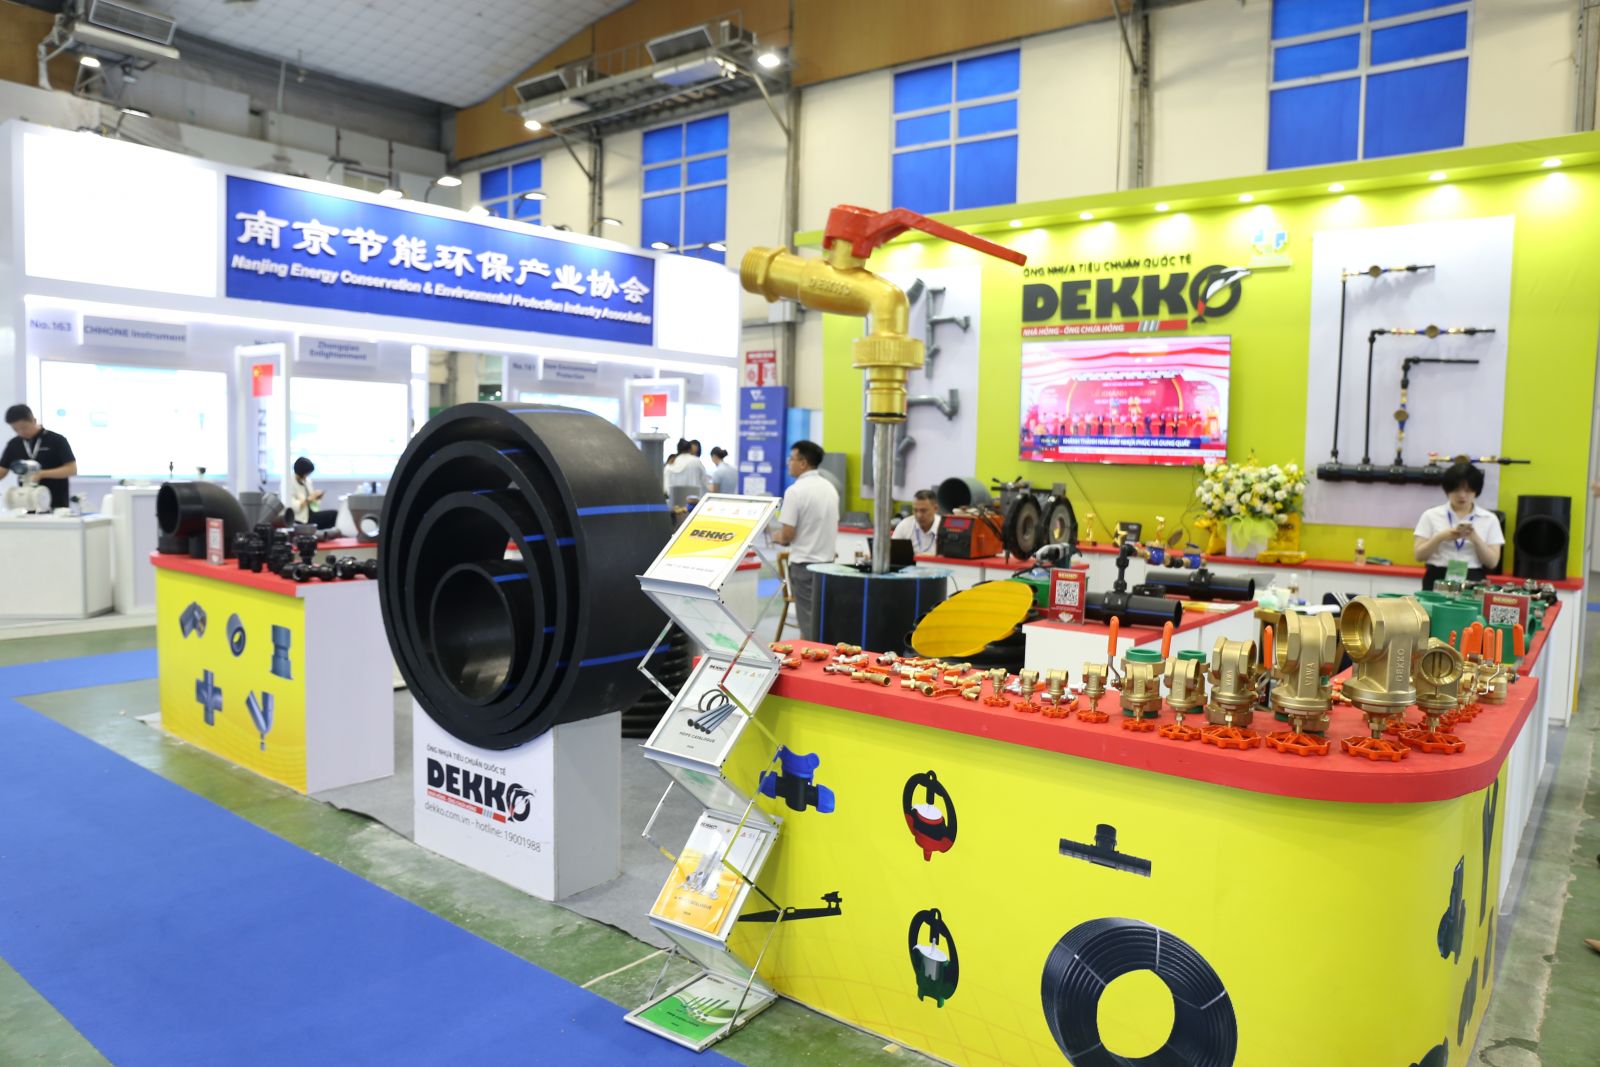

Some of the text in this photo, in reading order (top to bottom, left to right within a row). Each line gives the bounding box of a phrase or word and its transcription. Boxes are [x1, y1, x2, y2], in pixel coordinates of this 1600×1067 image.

[235, 209, 650, 304] 南京节能环保产业协会
[231, 254, 652, 325] Nanjing Energy Conservation & Environmental Protection Industry Association
[1022, 264, 1243, 324] DEKKO
[131, 329, 187, 343] Instrument
[427, 757, 532, 822] DEKKO
[425, 801, 471, 826] dekko.com.vn
[475, 821, 503, 838] hotline:
[504, 830, 541, 853] 19001988
